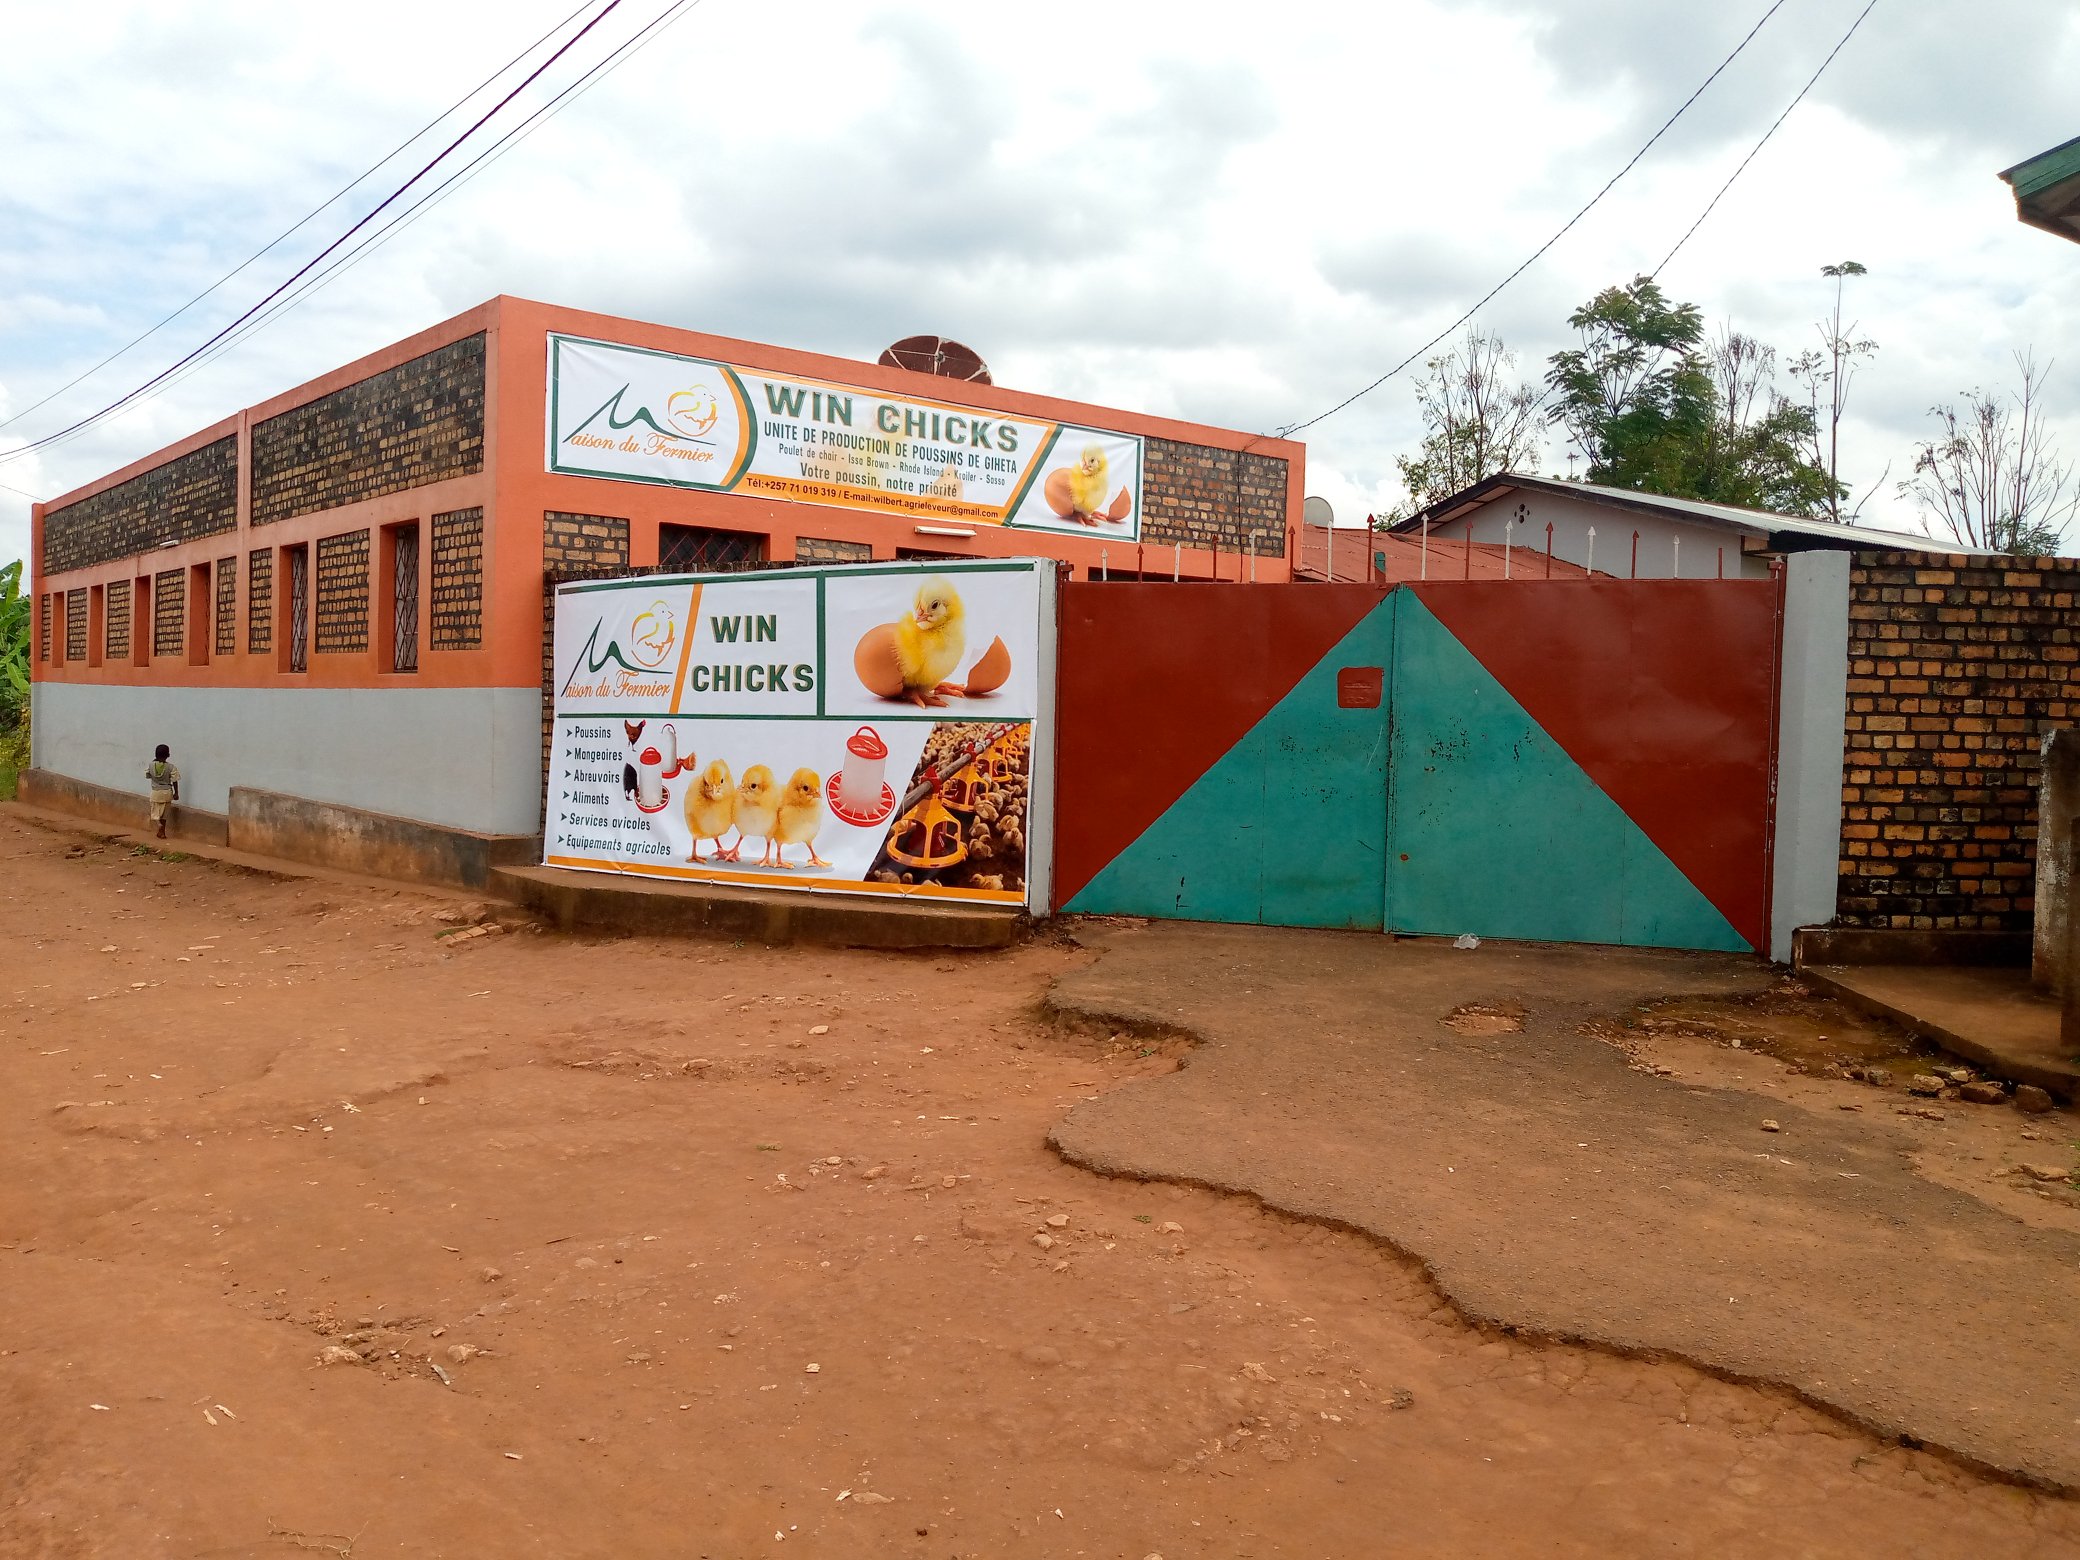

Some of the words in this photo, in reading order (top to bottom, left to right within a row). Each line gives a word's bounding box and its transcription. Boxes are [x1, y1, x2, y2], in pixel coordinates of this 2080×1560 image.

[763, 383, 852, 427] WIN
[877, 404, 1019, 453] CHICKS
[619, 435, 640, 453] du
[643, 432, 714, 462] Fermier
[764, 421, 798, 441] UNITE
[803, 427, 816, 444] DE
[822, 430, 890, 455] PRODUCTION
[895, 441, 908, 457] DE
[912, 445, 963, 466] POUSSINS
[968, 453, 980, 468] DE
[984, 456, 1017, 474] GIHETA
[779, 443, 803, 458] Poulet
[807, 447, 816, 458] de
[819, 449, 838, 462] chair
[866, 456, 890, 469] Brown
[900, 461, 921, 474] Rhode
[924, 464, 944, 477] Island
[747, 477, 787, 491] Tél:+257
[790, 483, 800, 493] 71
[803, 485, 819, 495] 019
[821, 487, 836, 497] 319
[800, 462, 830, 480] Votre
[836, 471, 880, 489] poussin,
[886, 477, 914, 492] notre
[919, 482, 957, 497] priorité
[710, 614, 777, 643] WIN
[595, 676, 611, 698] du
[613, 669, 671, 698] Fermier
[691, 664, 814, 693] CHICKS
[575, 726, 611, 739] Poussins
[574, 747, 623, 763] Mangeoires
[573, 769, 620, 784] Abreuvoirs
[572, 790, 610, 805] Aliments
[569, 812, 608, 828] Services
[612, 816, 651, 831] avicoles
[566, 834, 622, 851] Equipements
[625, 840, 671, 856] agricoles
